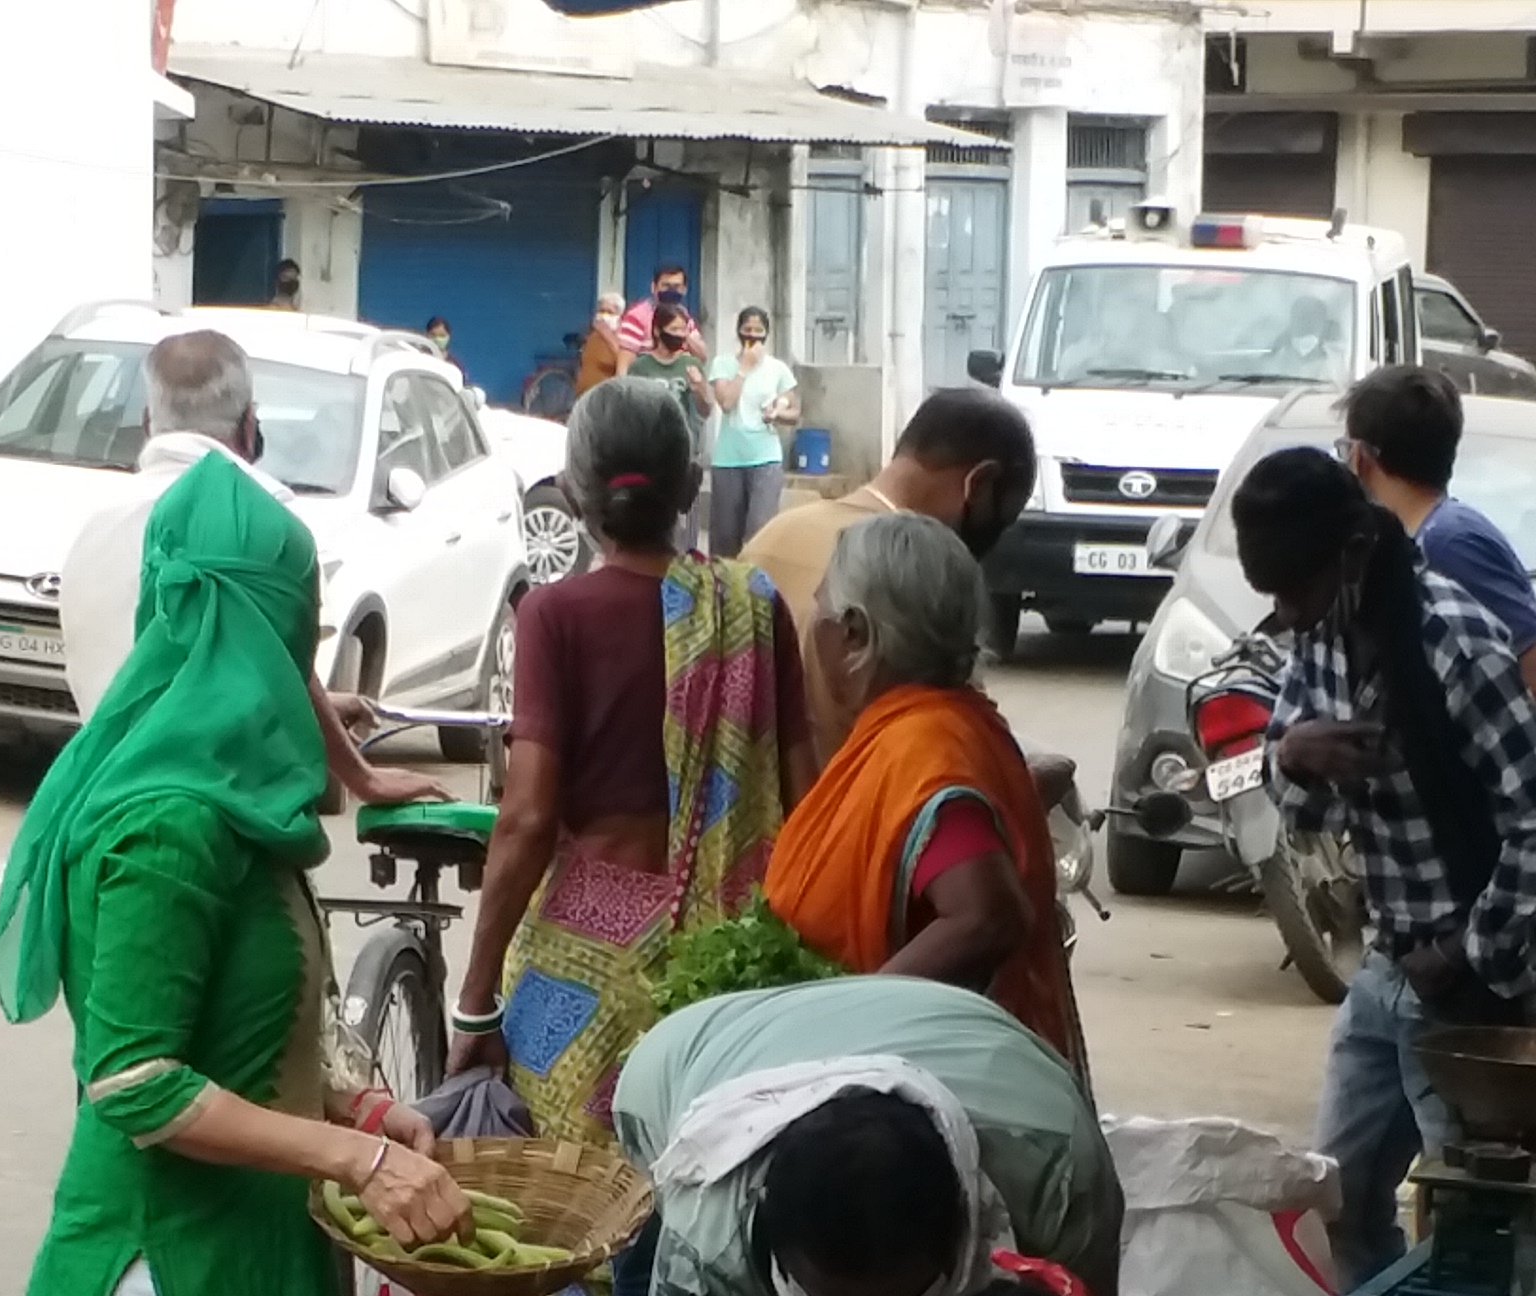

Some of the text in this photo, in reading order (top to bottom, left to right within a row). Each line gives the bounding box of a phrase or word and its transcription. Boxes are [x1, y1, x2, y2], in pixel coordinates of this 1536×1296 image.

[1088, 551, 1137, 570] CG 03
[18, 636, 39, 652] 04
